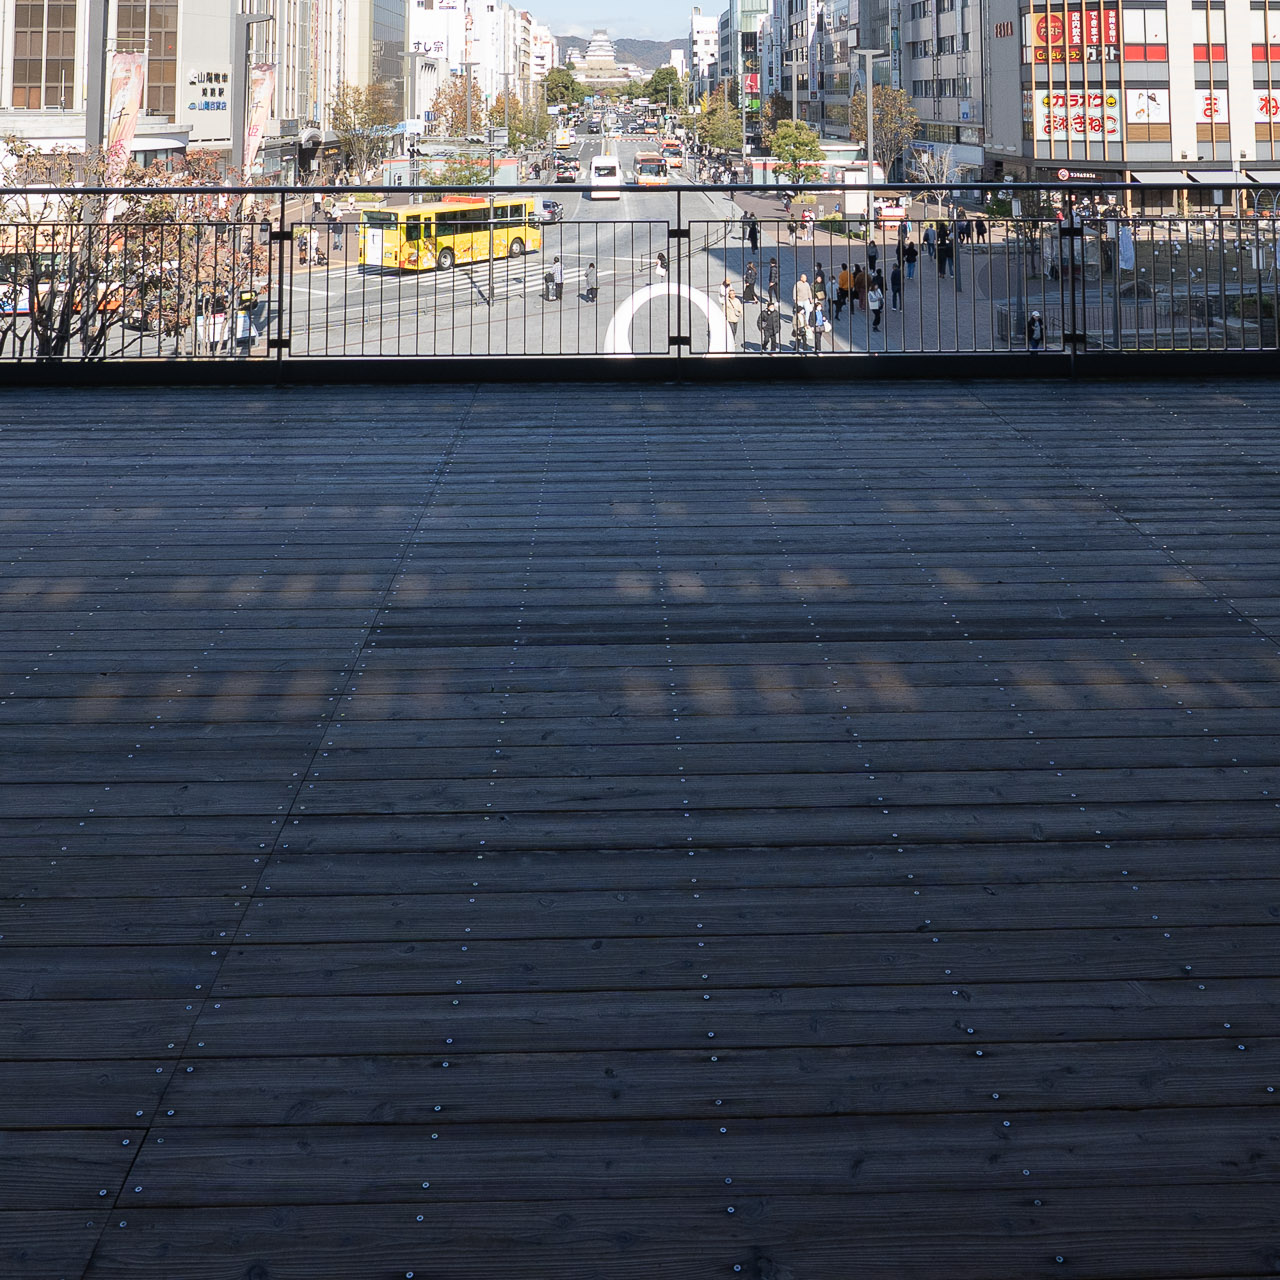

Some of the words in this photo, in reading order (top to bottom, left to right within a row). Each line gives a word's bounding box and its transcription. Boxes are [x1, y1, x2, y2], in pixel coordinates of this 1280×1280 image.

[1072, 12, 1081, 43] 店内飲食
[1090, 11, 1099, 43] できます
[1108, 11, 1117, 43] お持ち帰り
[412, 41, 444, 53] すし宗
[1052, 93, 1104, 108] カラオケ
[1043, 112, 1118, 135] まねきねこ
